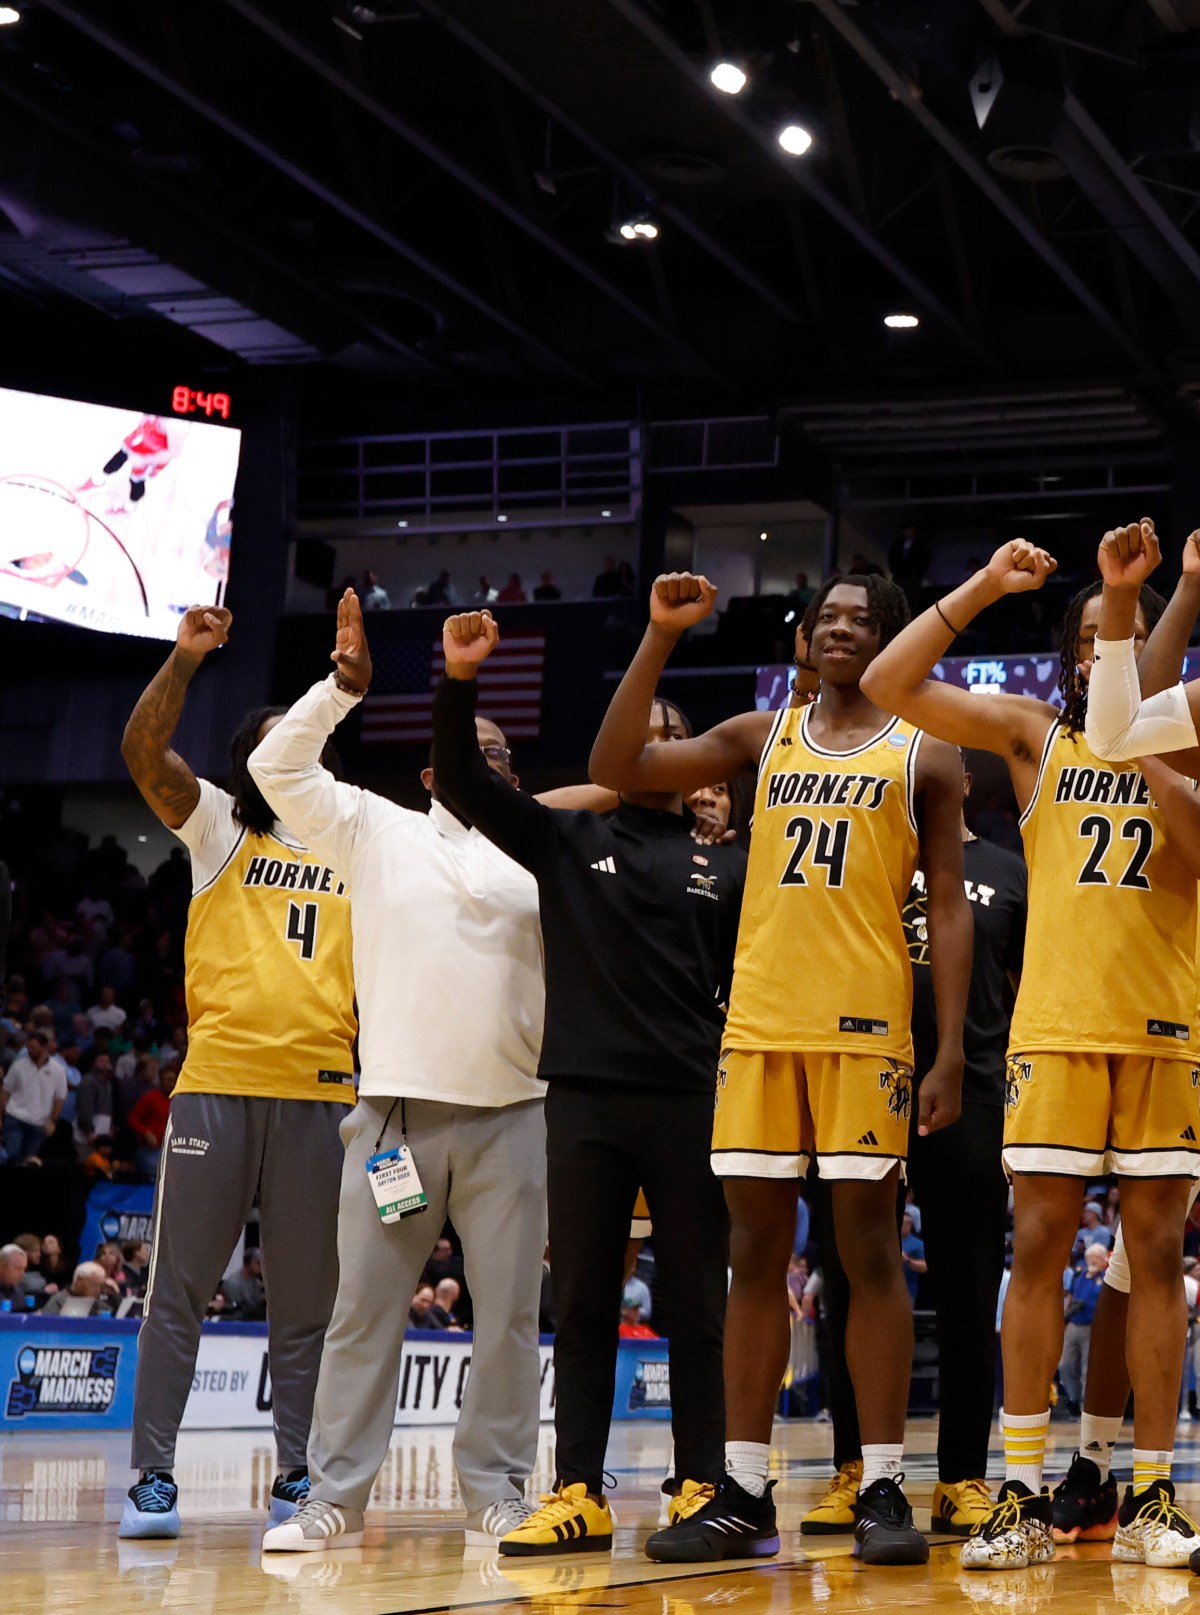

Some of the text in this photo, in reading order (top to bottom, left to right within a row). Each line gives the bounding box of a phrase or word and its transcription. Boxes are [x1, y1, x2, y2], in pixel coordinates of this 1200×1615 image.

[172, 385, 231, 419] 8:49
[966, 661, 1006, 685] FT%
[765, 771, 896, 811] HORNETS
[1054, 766, 1159, 809] HORNE
[778, 814, 851, 888] 24
[1076, 814, 1152, 892] 22
[242, 855, 351, 899] HORNE
[686, 886, 719, 901] BASKETBALL
[285, 899, 319, 962] 4
[376, 1169, 392, 1181] FIRST
[393, 1165, 408, 1176] FOUR
[386, 1196, 421, 1215] ALL ACCESS
[34, 1350, 92, 1377] MARCH
[39, 1377, 115, 1404] MADNESS
[192, 1370, 227, 1392] STED
[230, 1370, 250, 1392] BY
